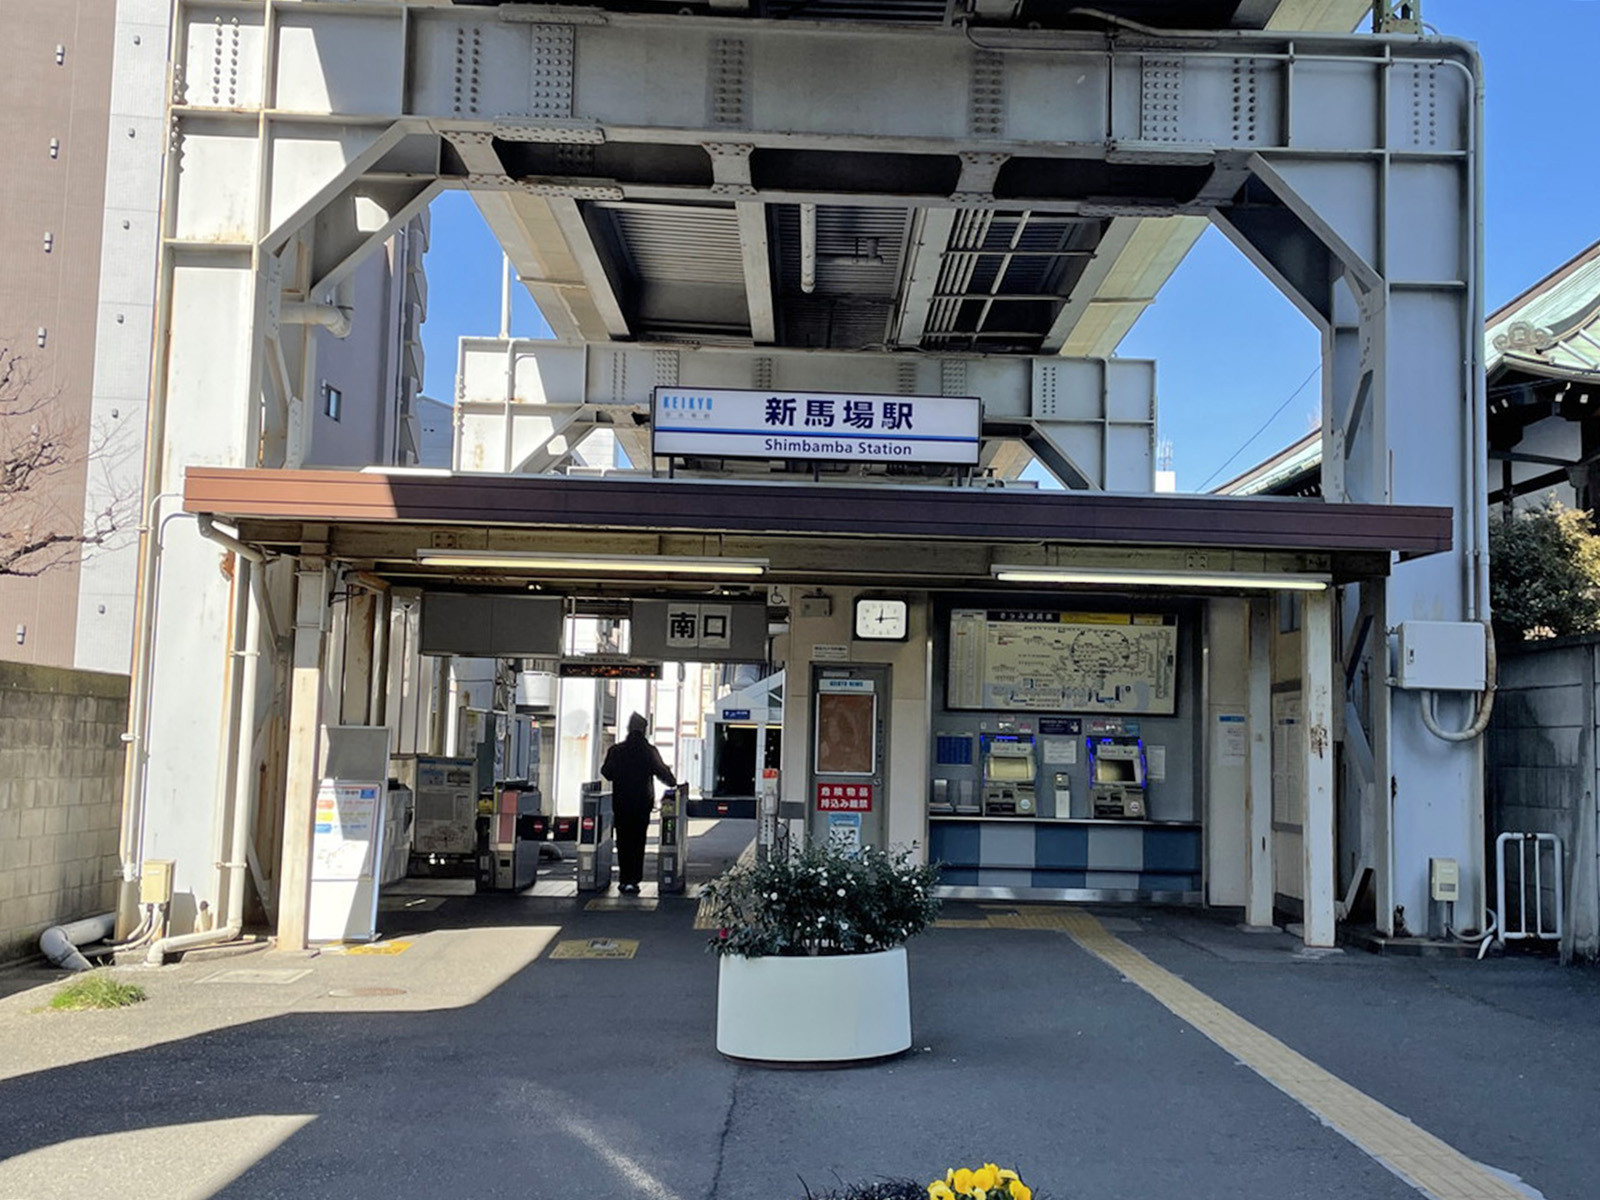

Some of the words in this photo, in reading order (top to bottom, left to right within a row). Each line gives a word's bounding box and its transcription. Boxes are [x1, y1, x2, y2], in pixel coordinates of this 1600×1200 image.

[663, 396, 713, 411] KEIKYU
[765, 397, 913, 430] 新馬場駅
[765, 438, 853, 454] Shimbamba
[858, 441, 912, 456] Station
[670, 611, 727, 639] 南口
